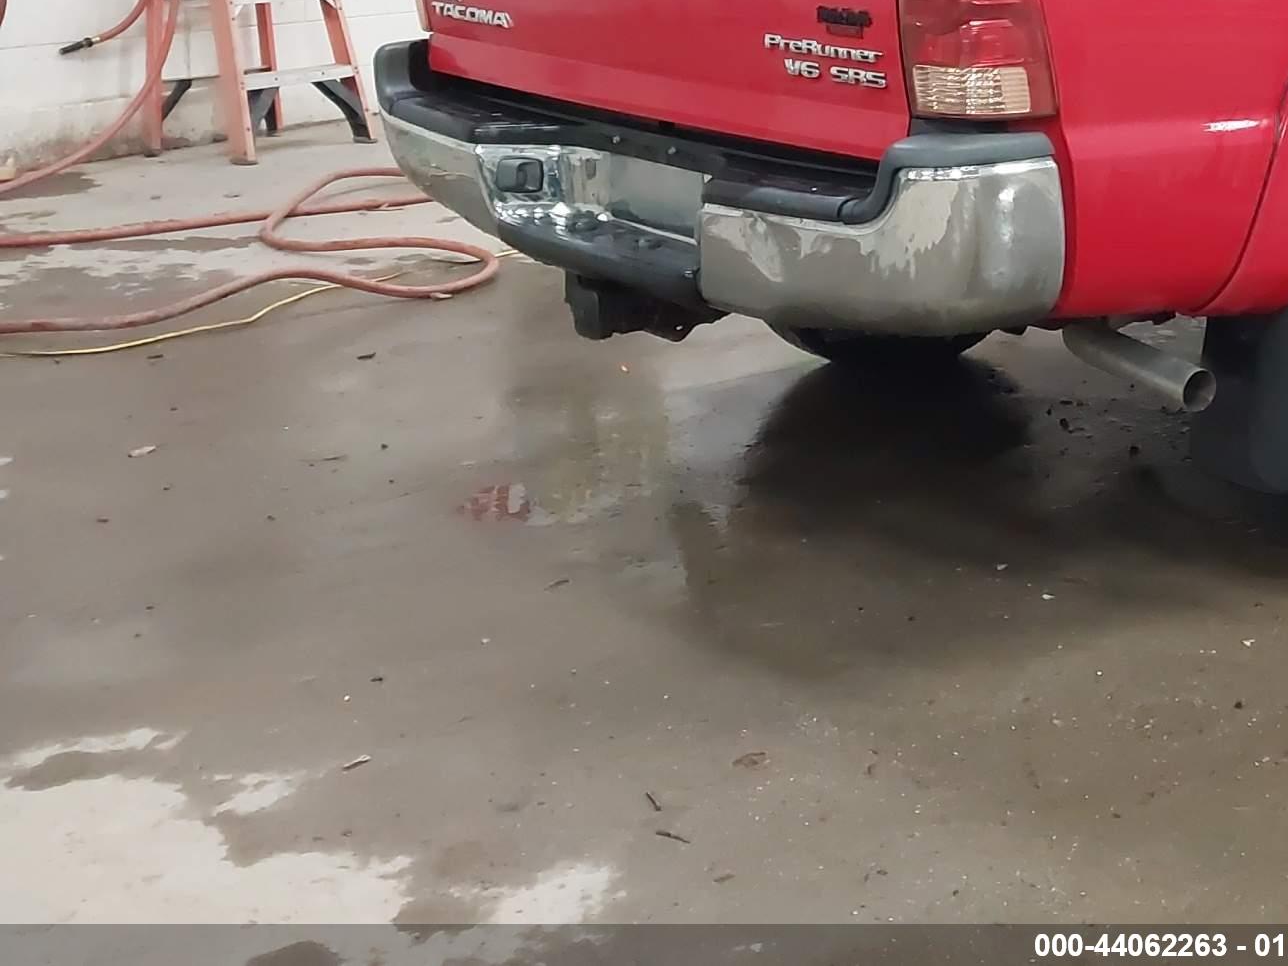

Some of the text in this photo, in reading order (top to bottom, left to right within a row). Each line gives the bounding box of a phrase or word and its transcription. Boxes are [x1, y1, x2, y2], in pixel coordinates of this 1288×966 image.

[431, 1, 513, 28] TACOMA
[764, 33, 883, 63] PreRunner
[784, 58, 820, 78] V6
